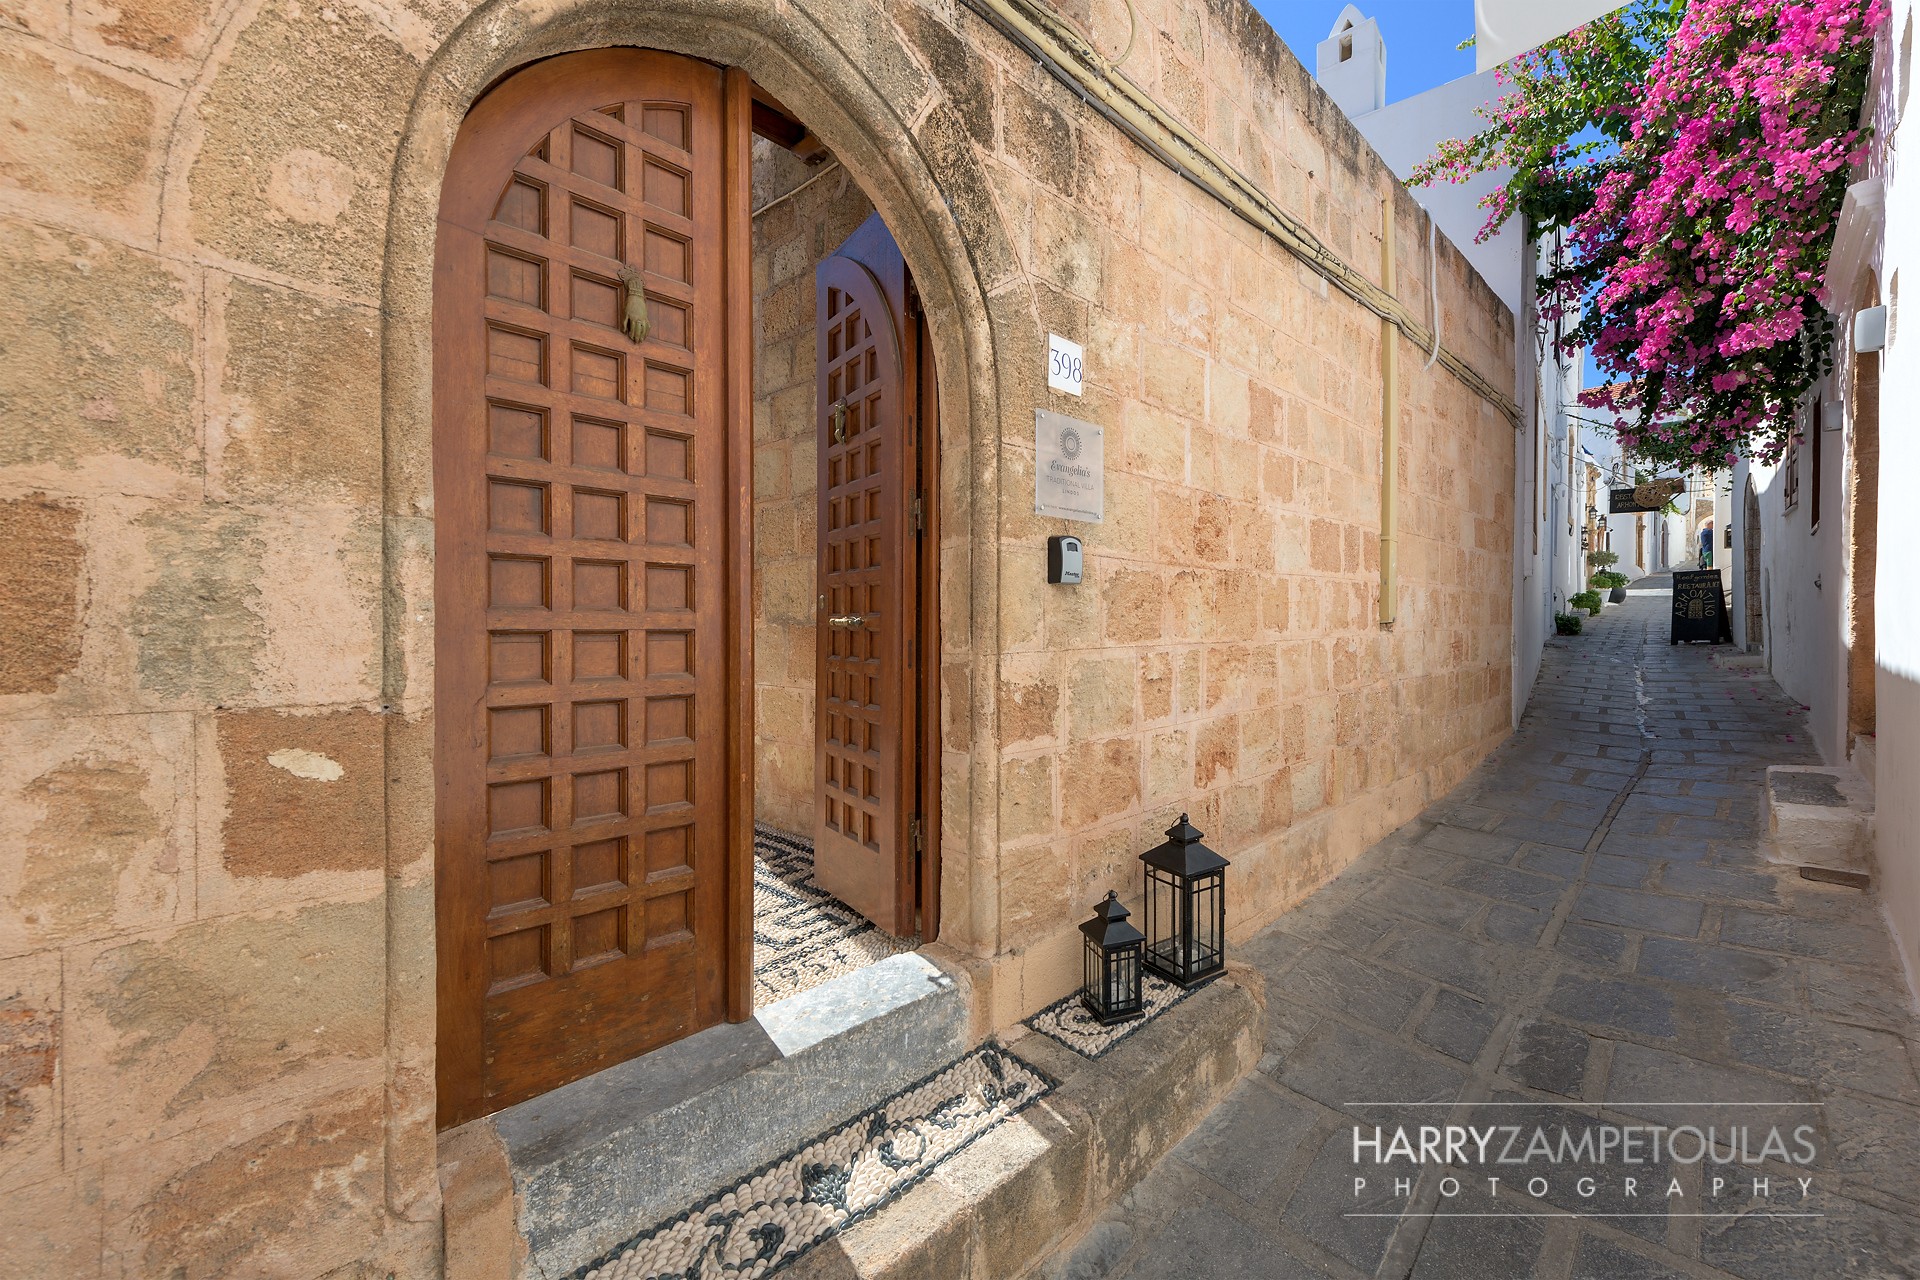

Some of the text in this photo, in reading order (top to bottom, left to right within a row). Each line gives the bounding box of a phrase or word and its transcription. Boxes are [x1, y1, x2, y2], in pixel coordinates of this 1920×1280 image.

[1050, 348, 1082, 384] 398
[1050, 460, 1091, 478] Evangelia's
[1046, 475, 1080, 489] TRADITIONAL
[1675, 589, 1716, 618] ARHONTIKO
